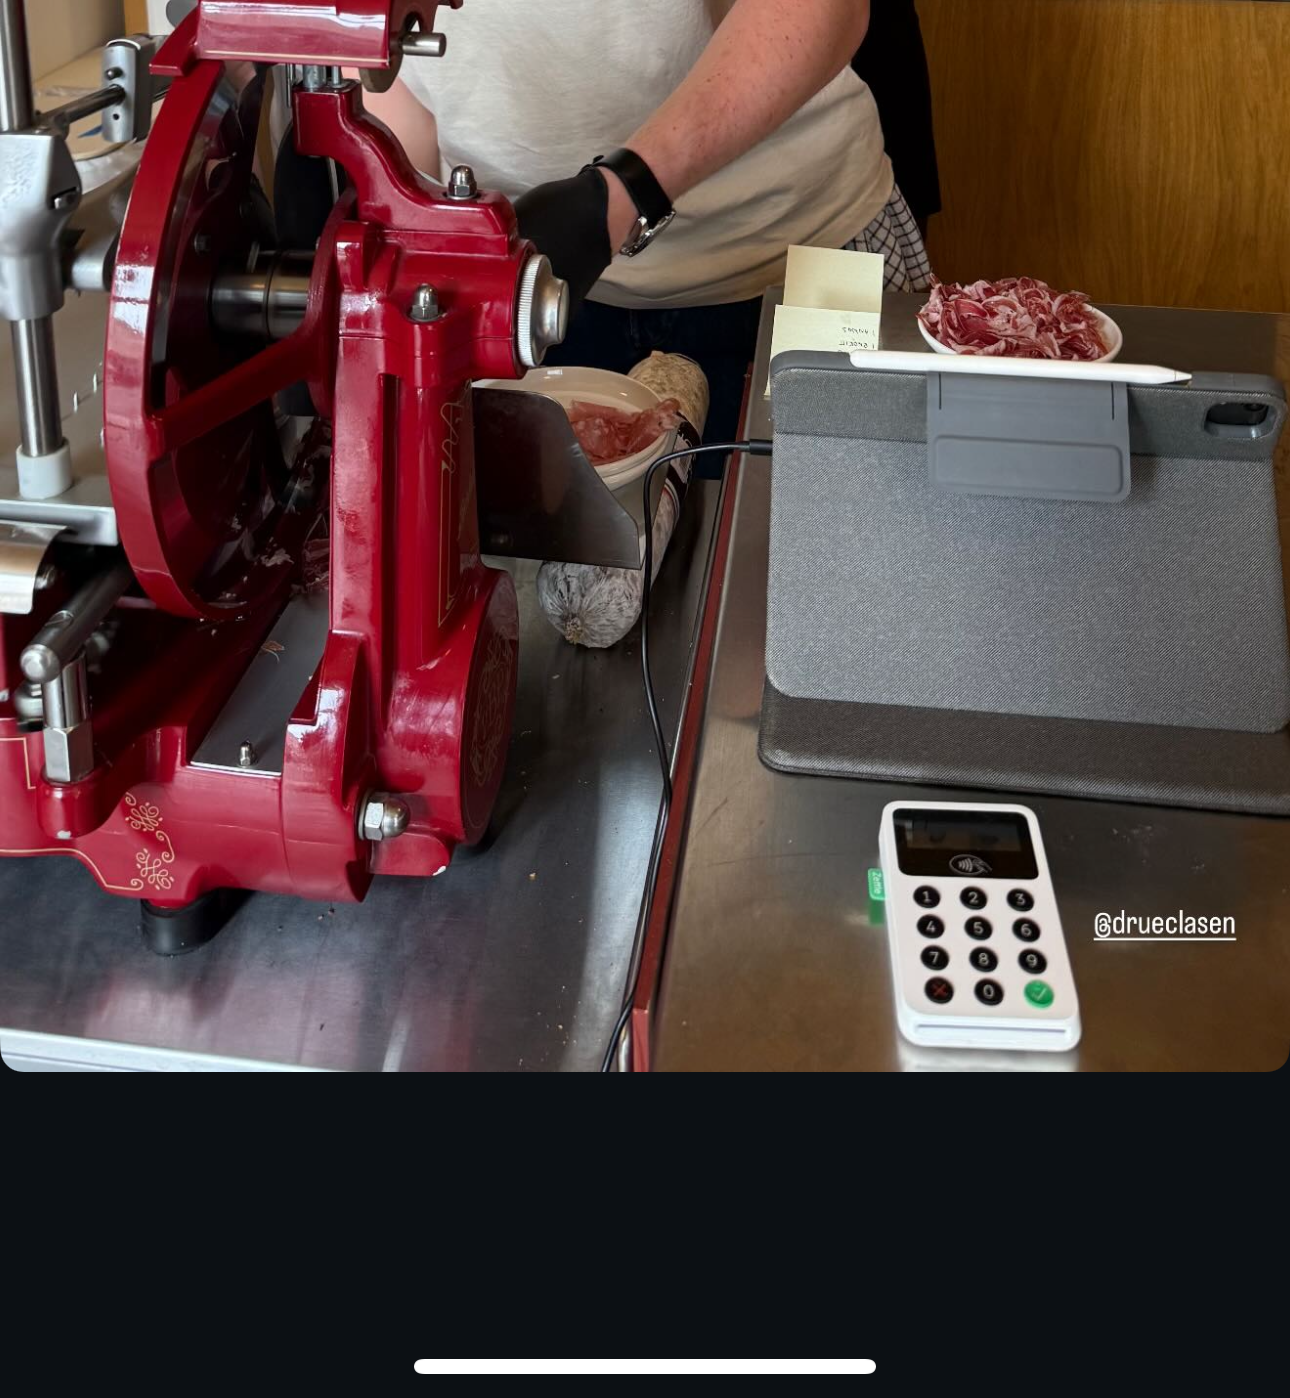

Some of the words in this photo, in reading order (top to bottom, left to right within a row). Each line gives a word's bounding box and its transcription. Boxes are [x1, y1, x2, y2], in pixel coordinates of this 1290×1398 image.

[922, 891, 933, 904] 1
[968, 891, 979, 905] 2
[1015, 893, 1026, 906] 3
[925, 920, 937, 933] 4
[973, 921, 984, 934] 5
[1020, 923, 1032, 936] 6
[929, 951, 941, 964] 7
[978, 952, 989, 966] 8
[1026, 954, 1038, 967] 9
[983, 985, 994, 999] 0
